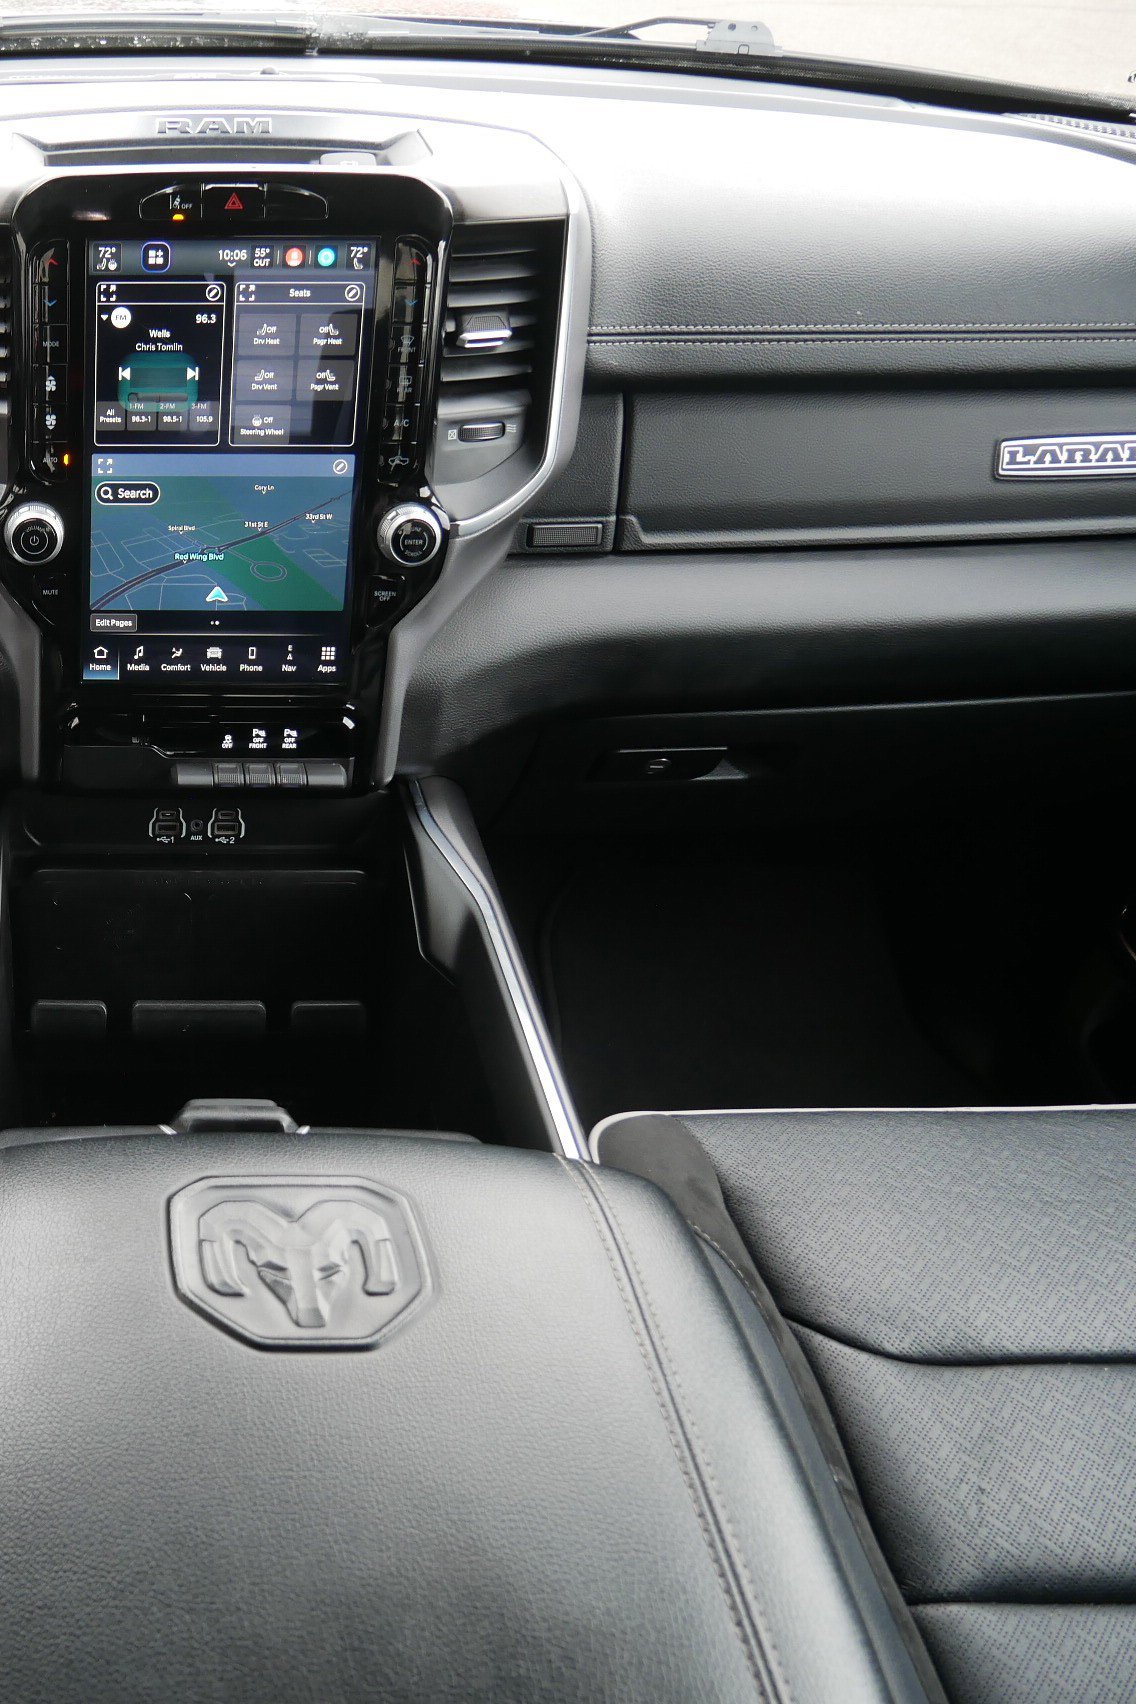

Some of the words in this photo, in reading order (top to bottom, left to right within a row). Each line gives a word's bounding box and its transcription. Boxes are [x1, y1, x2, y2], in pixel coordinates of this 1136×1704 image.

[155, 117, 272, 134] RAM
[219, 250, 247, 261] 10:06
[254, 259, 270, 267] OUT
[289, 289, 311, 298] Seats
[195, 314, 217, 324] 96.3
[135, 343, 156, 351] Chris
[157, 343, 183, 351] Tomlin
[393, 419, 410, 427] A/C
[240, 429, 265, 437] Steering
[117, 488, 153, 499] Search
[174, 552, 188, 561] Red
[188, 552, 207, 562] Wing
[208, 552, 224, 561] Blvd
[95, 619, 110, 627] Edit
[111, 619, 133, 628] Pages
[89, 663, 112, 671] Home
[127, 663, 150, 671] Media
[160, 663, 191, 671] Comfort
[200, 663, 227, 671] Vehicle
[281, 664, 297, 672] Nav
[317, 664, 336, 673] Apps
